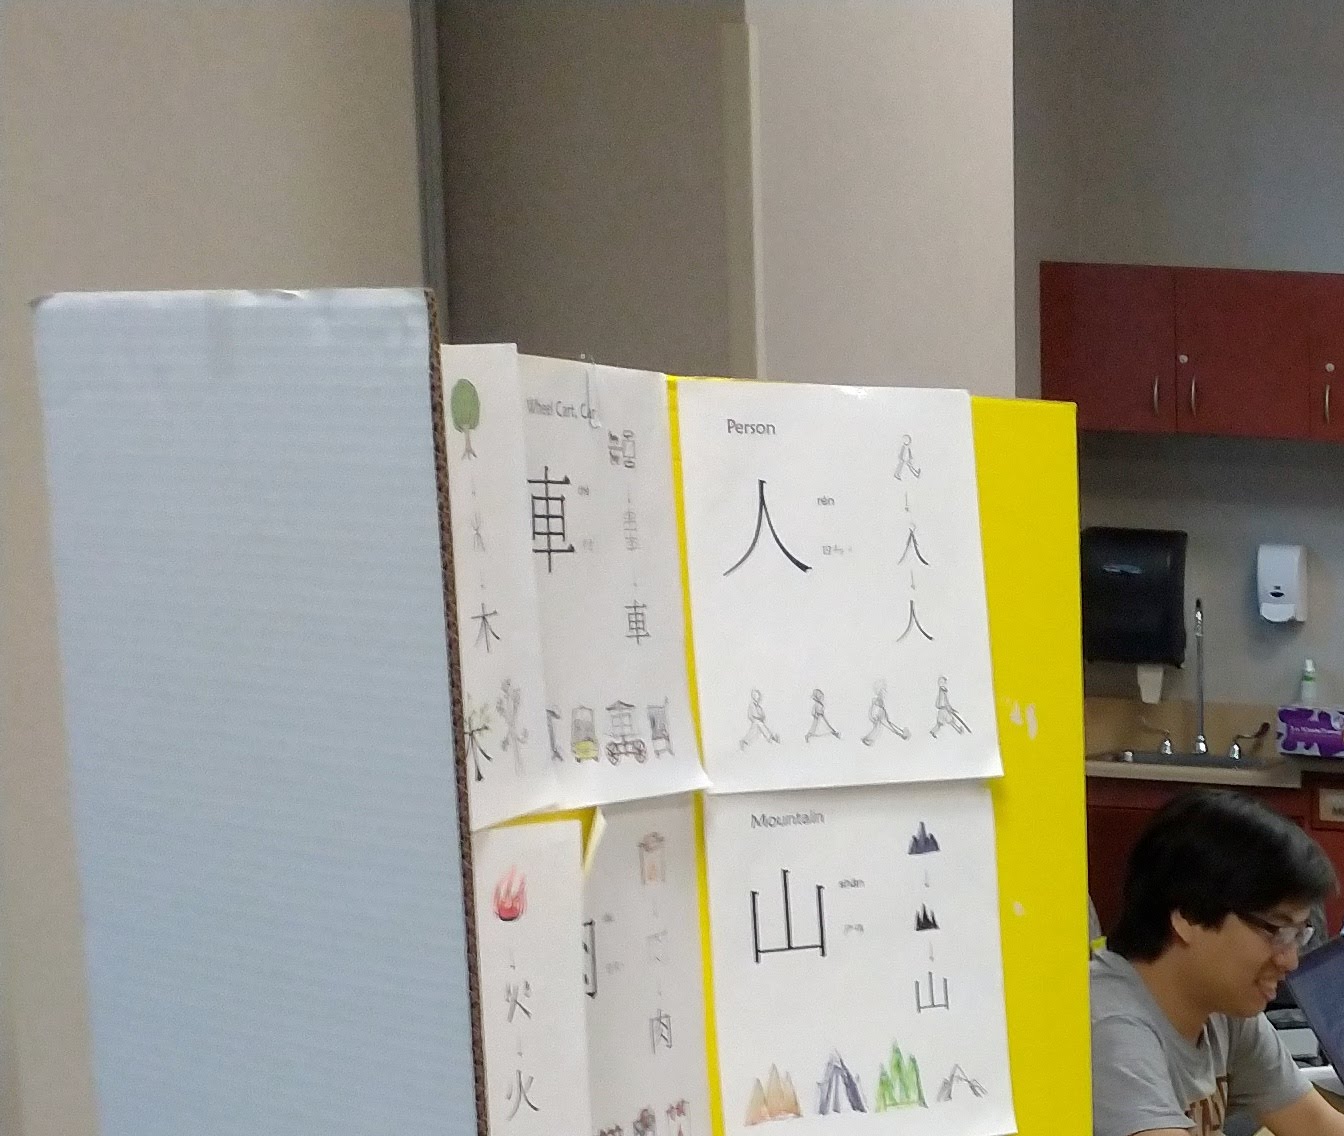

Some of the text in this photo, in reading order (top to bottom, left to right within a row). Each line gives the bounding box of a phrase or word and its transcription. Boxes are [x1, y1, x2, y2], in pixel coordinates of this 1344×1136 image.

[726, 418, 776, 435] Person
[527, 465, 575, 574] 車
[723, 479, 812, 577] 人
[624, 600, 651, 645] 車
[896, 600, 935, 642] 人
[751, 810, 825, 828] Mountain
[750, 868, 826, 964] 山
[915, 971, 949, 1013] 山
[505, 1069, 540, 1121] 火
